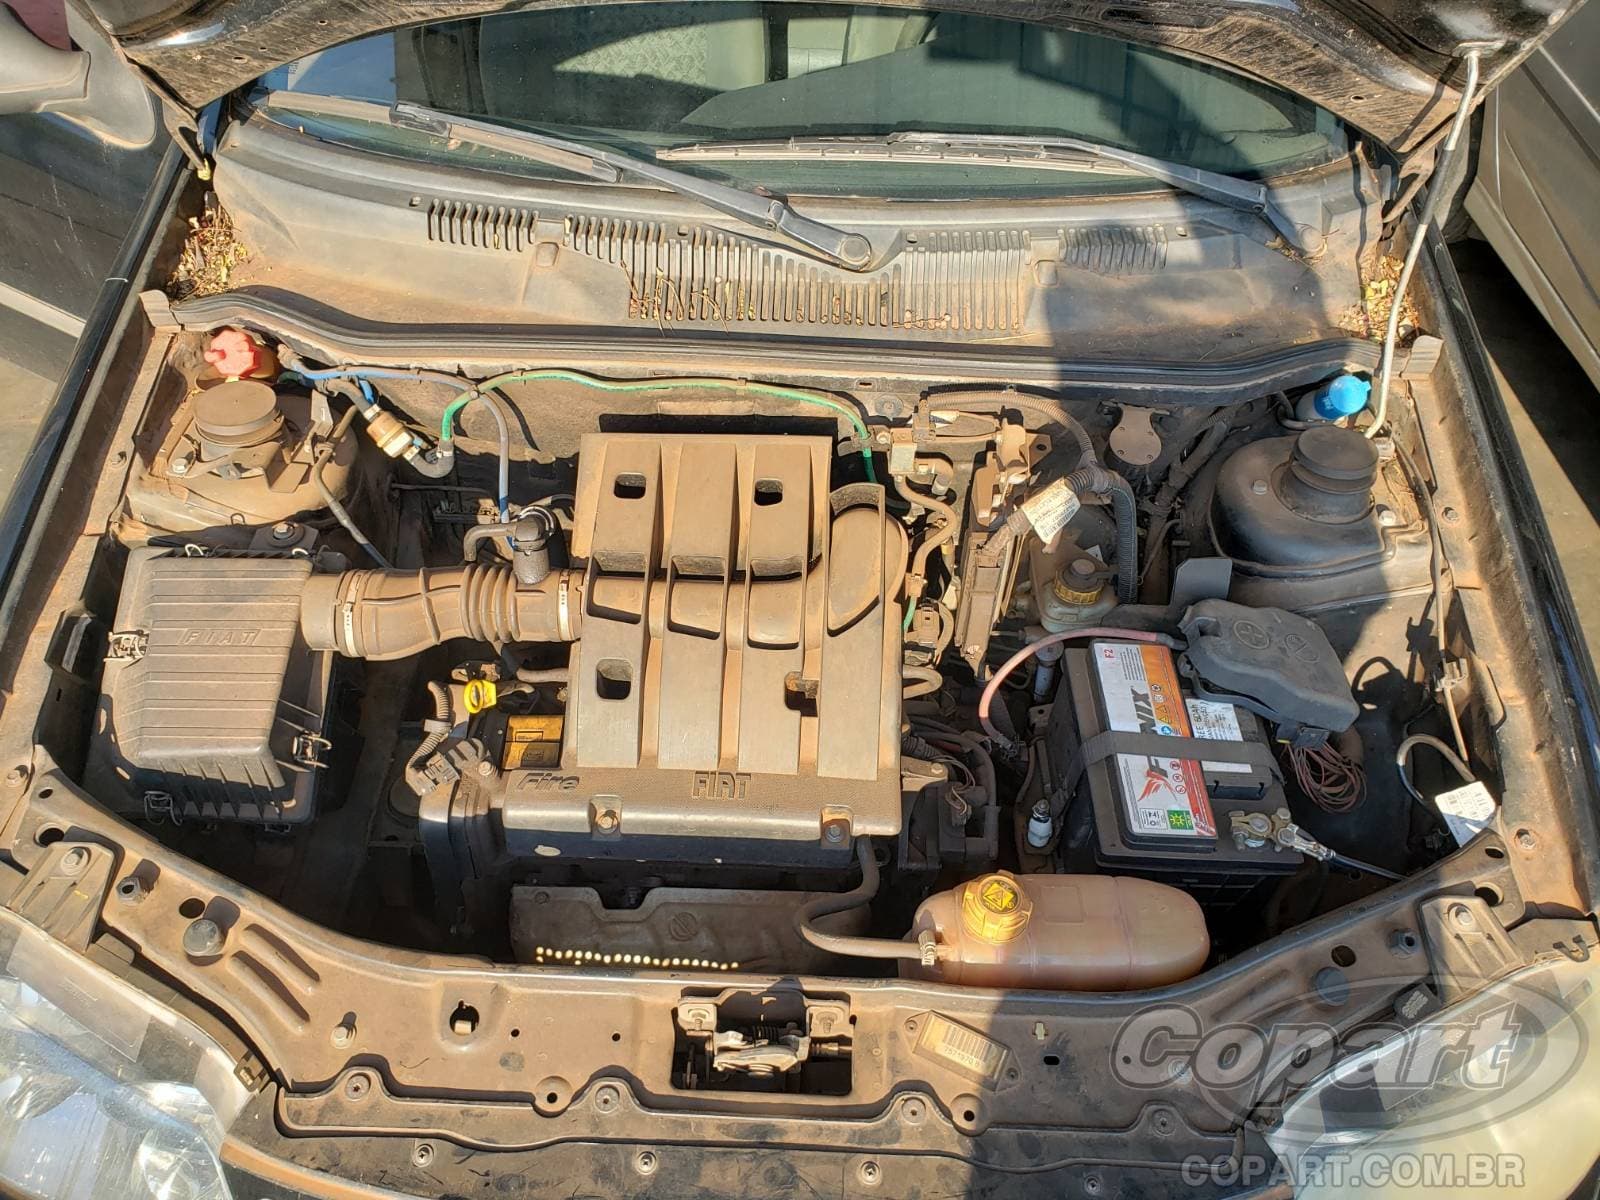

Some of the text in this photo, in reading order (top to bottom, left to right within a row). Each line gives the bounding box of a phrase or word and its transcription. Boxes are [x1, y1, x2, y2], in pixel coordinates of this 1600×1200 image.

[184, 630, 255, 645] FIAT
[516, 771, 580, 792] Fire
[691, 770, 751, 801] FIAT
